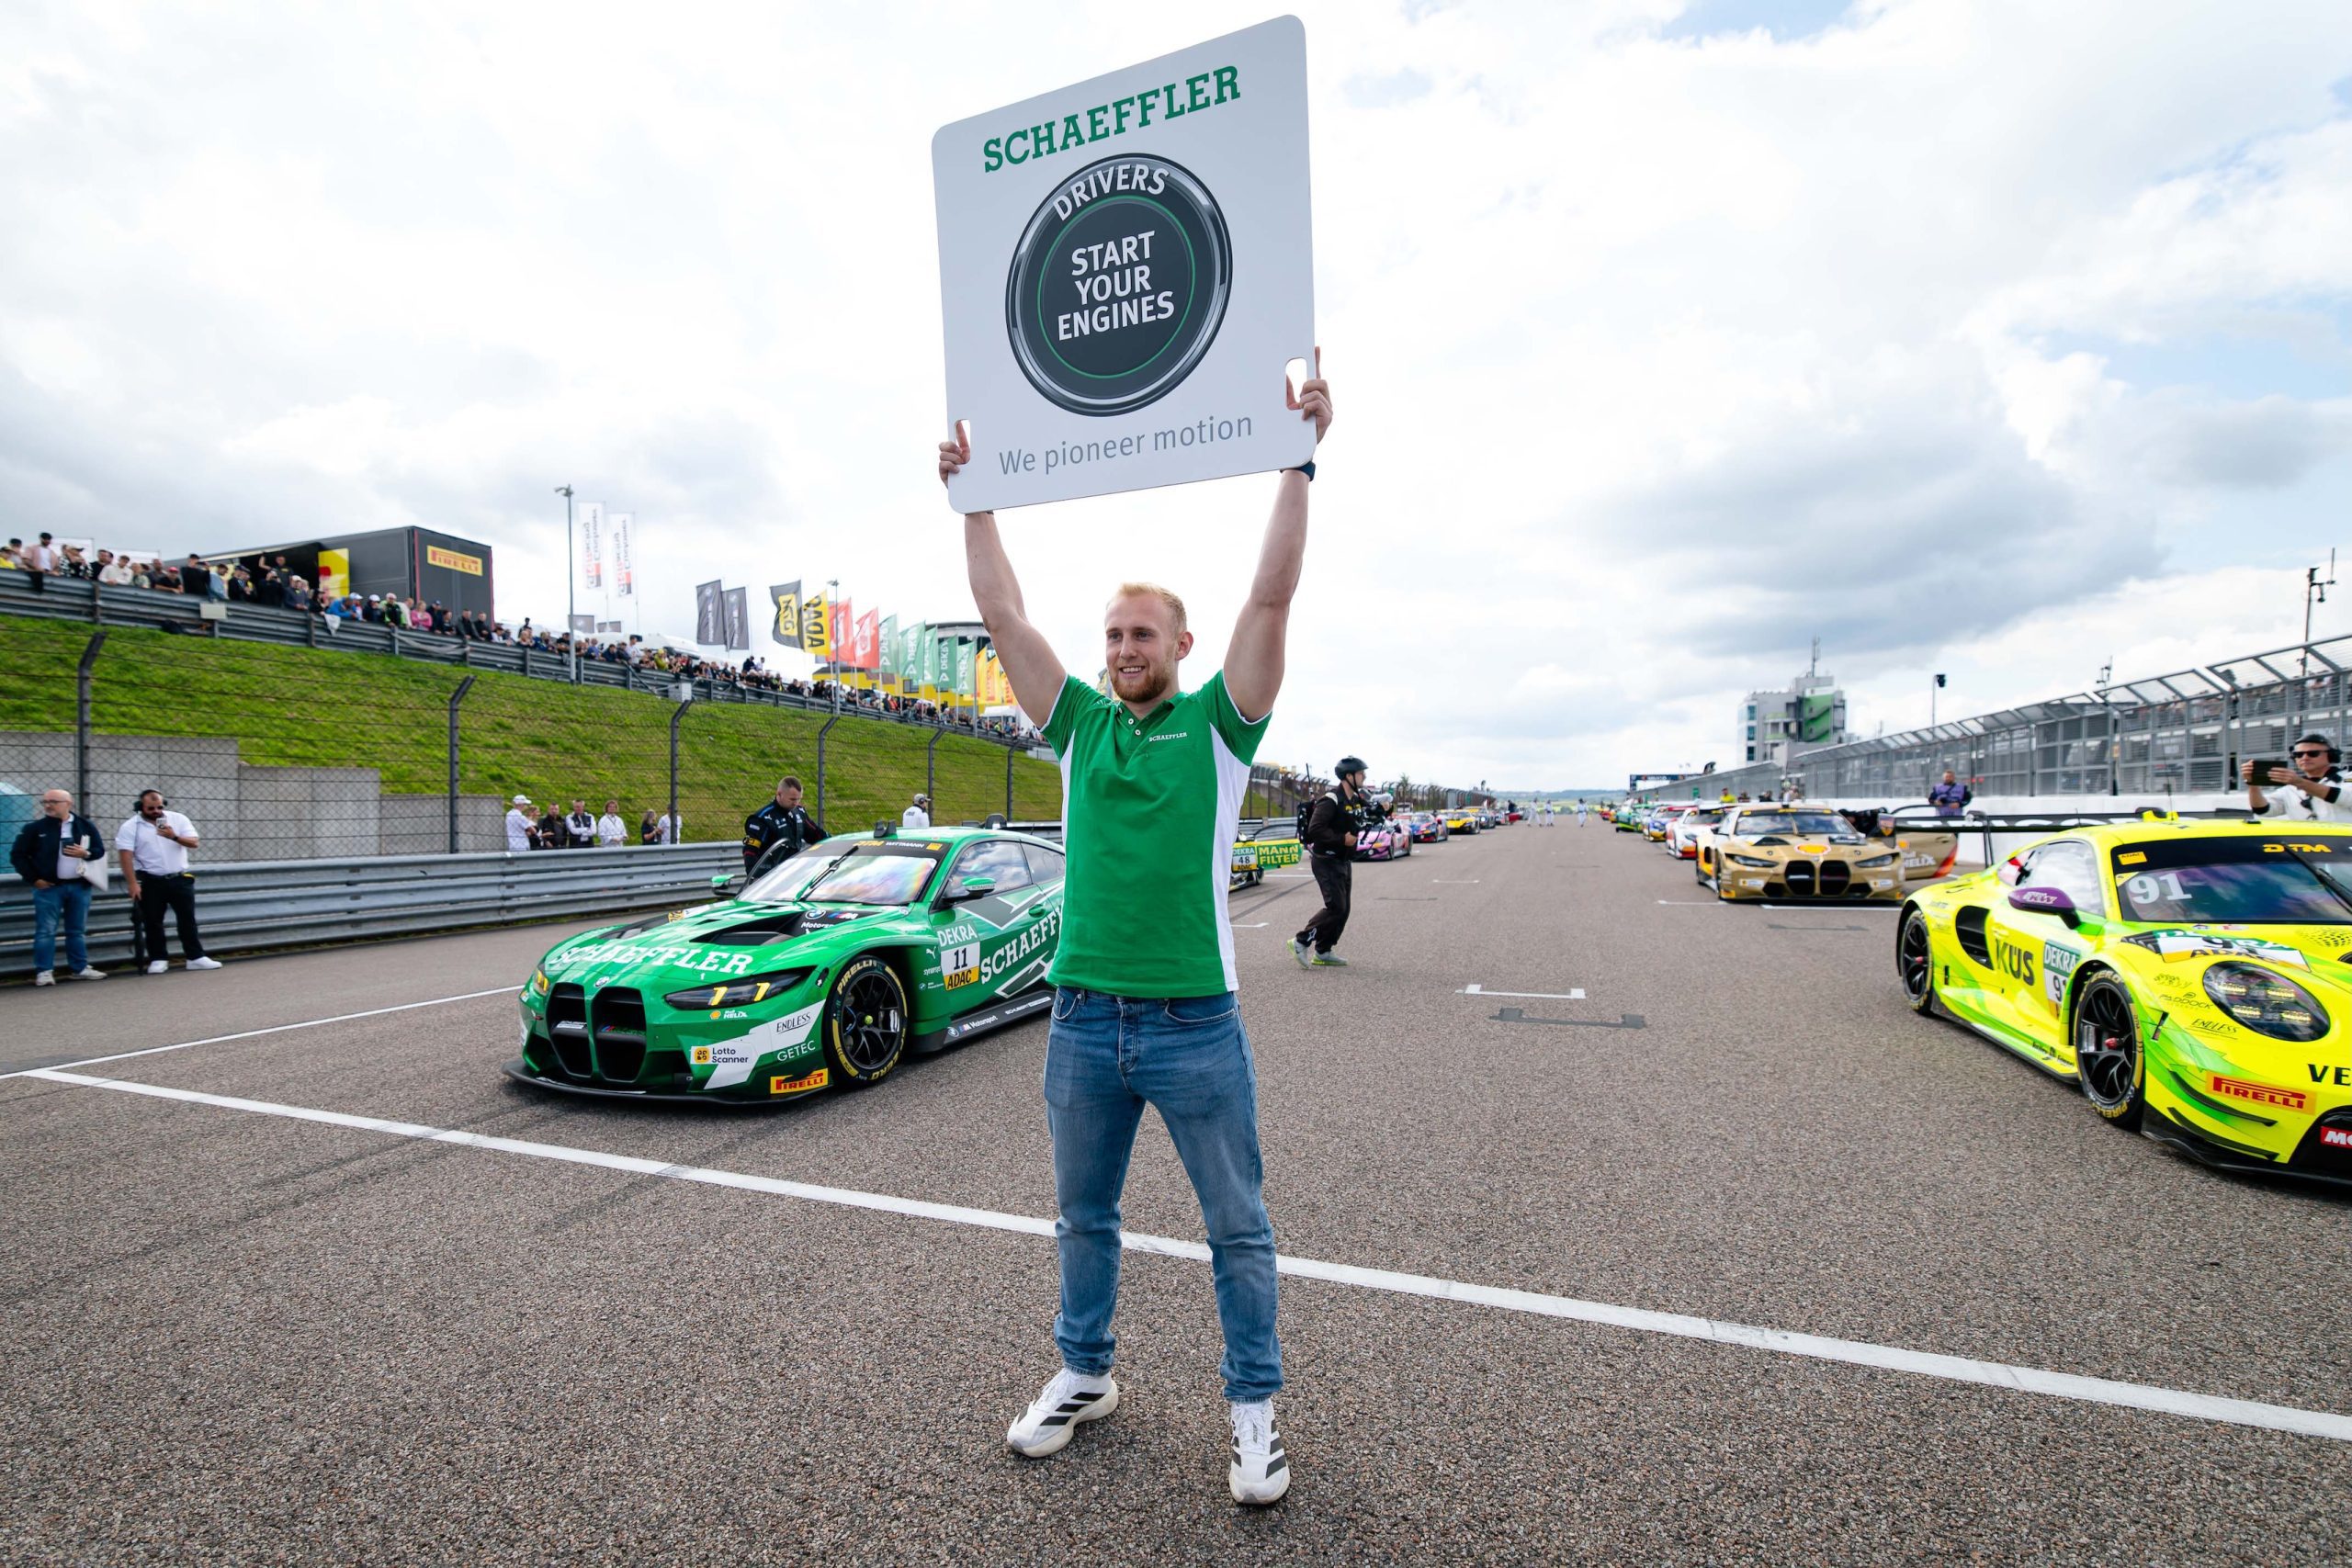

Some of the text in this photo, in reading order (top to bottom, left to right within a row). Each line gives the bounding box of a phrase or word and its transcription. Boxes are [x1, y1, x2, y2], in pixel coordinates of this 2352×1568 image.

[983, 65, 1240, 173] SCHAEFFLER
[1053, 164, 1170, 221] DRIVERS
[1071, 231, 1155, 276] START
[1075, 265, 1152, 305] YOUR
[1058, 291, 1174, 341] ENGINES
[1000, 415, 1252, 475] We pioneer motion
[1148, 732, 1187, 742] SCHAEFFLER
[1259, 845, 1298, 855] MANN
[1260, 854, 1299, 865] FILTER
[2263, 843, 2332, 852] DTM
[2128, 874, 2192, 904] 91
[937, 923, 978, 947] DEKRA
[549, 944, 753, 975] SCHAEFFLER
[954, 948, 968, 971] 11
[2044, 943, 2077, 975] DEKRA
[837, 959, 874, 995] PIRELLI
[946, 969, 972, 990] ADAC
[776, 1012, 811, 1032] ENDLESS
[2192, 1019, 2237, 1033] ENDLESS
[777, 1040, 816, 1062] GETEC
[775, 1072, 824, 1090] PIRELLI
[2213, 1077, 2307, 1109] PIRELLI
